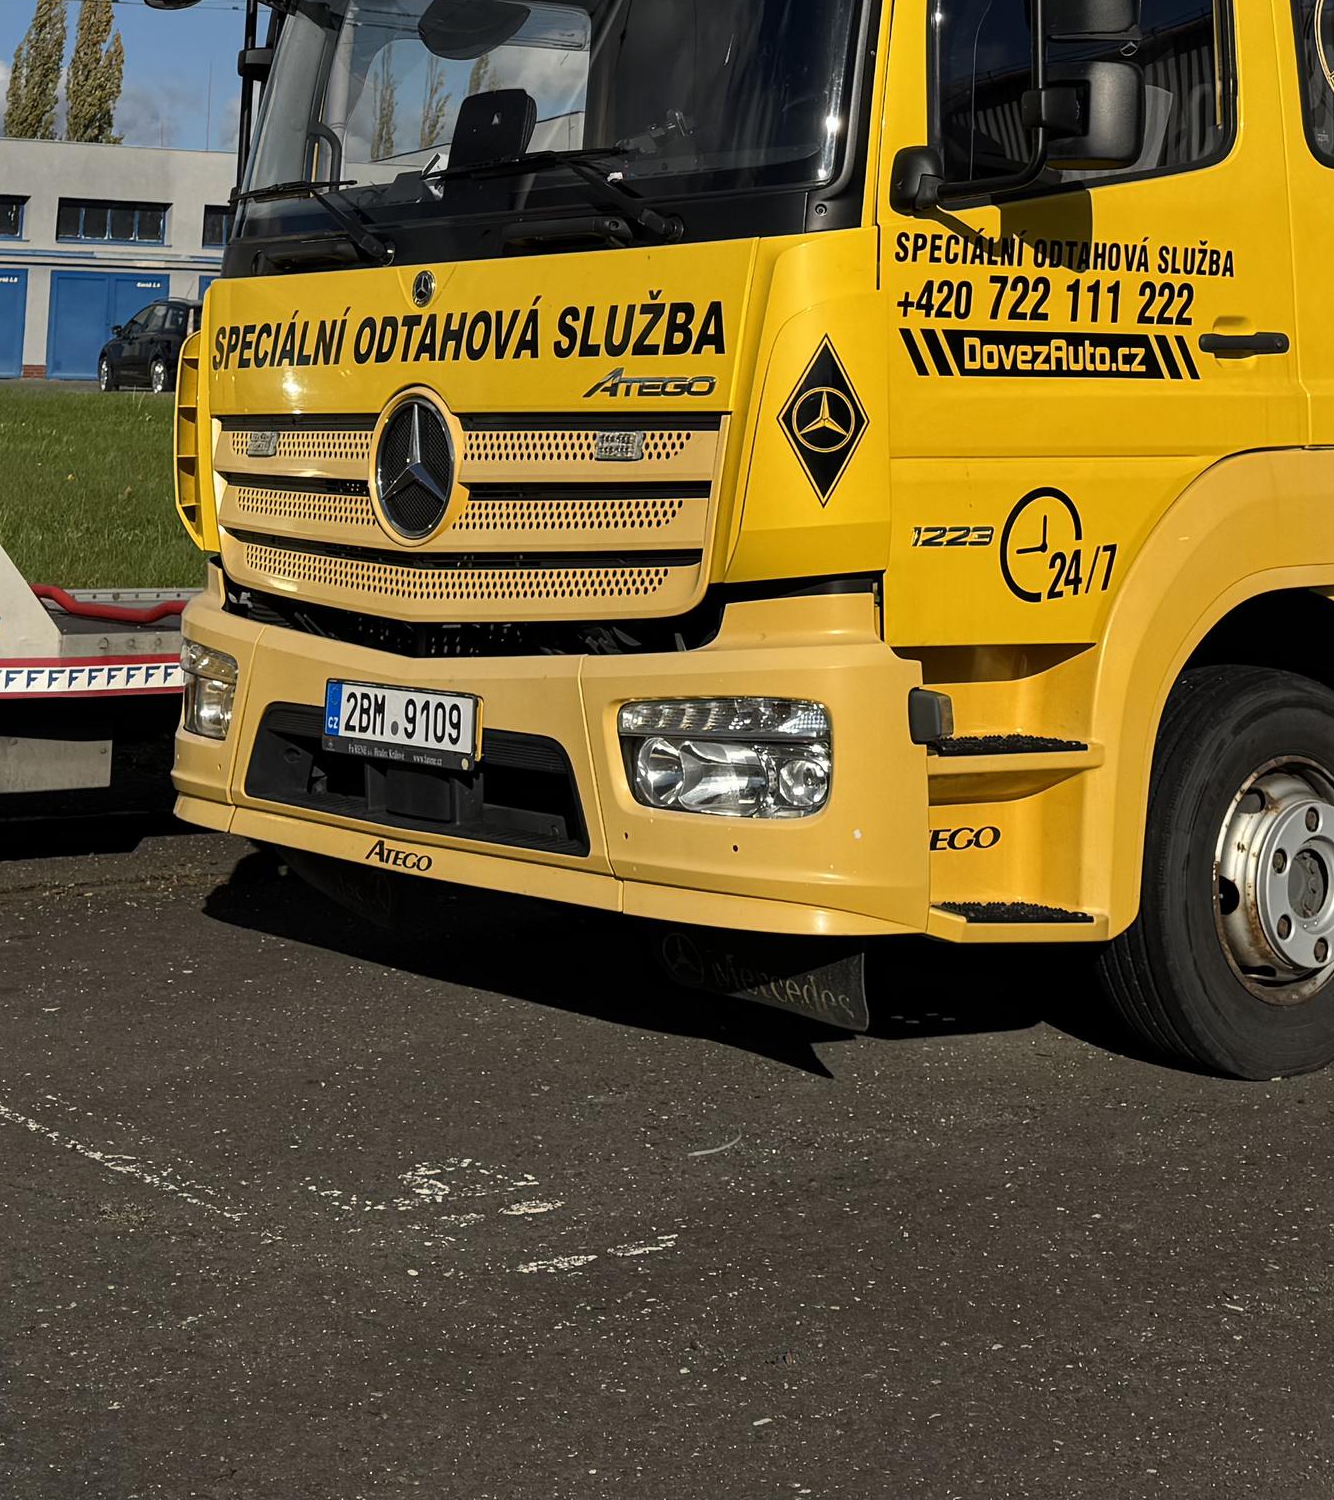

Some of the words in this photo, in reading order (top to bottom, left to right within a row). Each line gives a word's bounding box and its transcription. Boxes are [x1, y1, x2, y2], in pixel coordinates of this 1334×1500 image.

[894, 227, 1028, 268] SPECIÁLNÍ
[1033, 236, 1150, 273] ODTAHOVÁ
[1157, 240, 1235, 278] SLUŽBA
[897, 279, 973, 320] +420
[988, 275, 1051, 321] 722
[1066, 278, 1121, 323] 111
[1137, 280, 1195, 326] 222
[212, 306, 351, 371] SPECIÁLNÍ
[353, 295, 542, 365] ODTAHOVÁ
[553, 290, 726, 359] SLUŽBA
[963, 337, 1147, 372] DovezAuto.cz
[911, 526, 995, 547] 1223
[1047, 543, 1117, 600] 24/7
[327, 716, 339, 729] CZ
[344, 691, 386, 736] 2BM
[403, 698, 462, 746] 9109
[929, 826, 1001, 851] EGO
